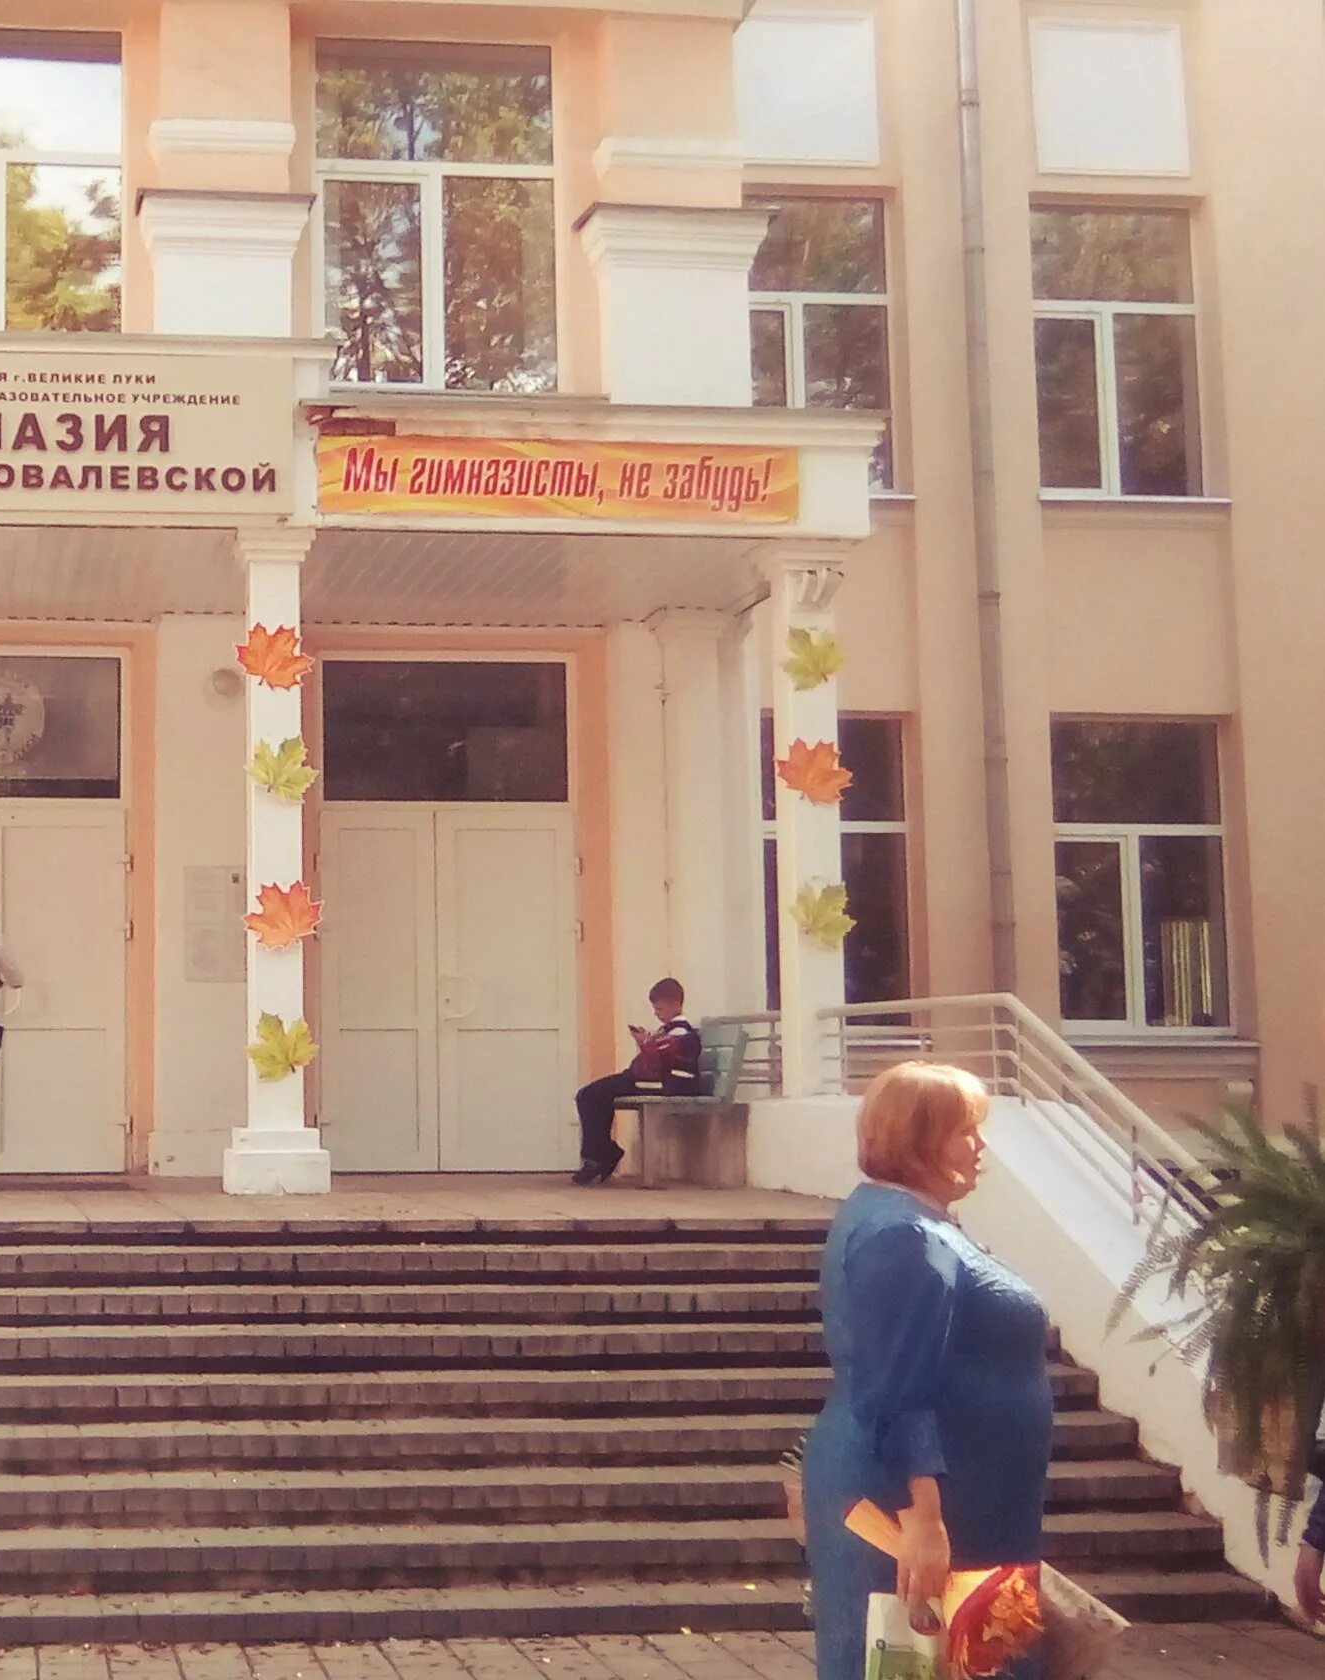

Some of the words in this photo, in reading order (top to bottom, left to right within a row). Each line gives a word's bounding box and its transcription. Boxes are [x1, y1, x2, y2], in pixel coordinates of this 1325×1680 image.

[14, 372, 106, 384] г.ВЕЛИКИЕ
[112, 374, 156, 385] ЛУКИ
[131, 393, 241, 406] УЧРЕЖДЕНИЕ
[343, 446, 397, 493] Мы
[409, 456, 604, 506] гимназисты,
[619, 461, 651, 497] не
[663, 456, 773, 512] забудь!
